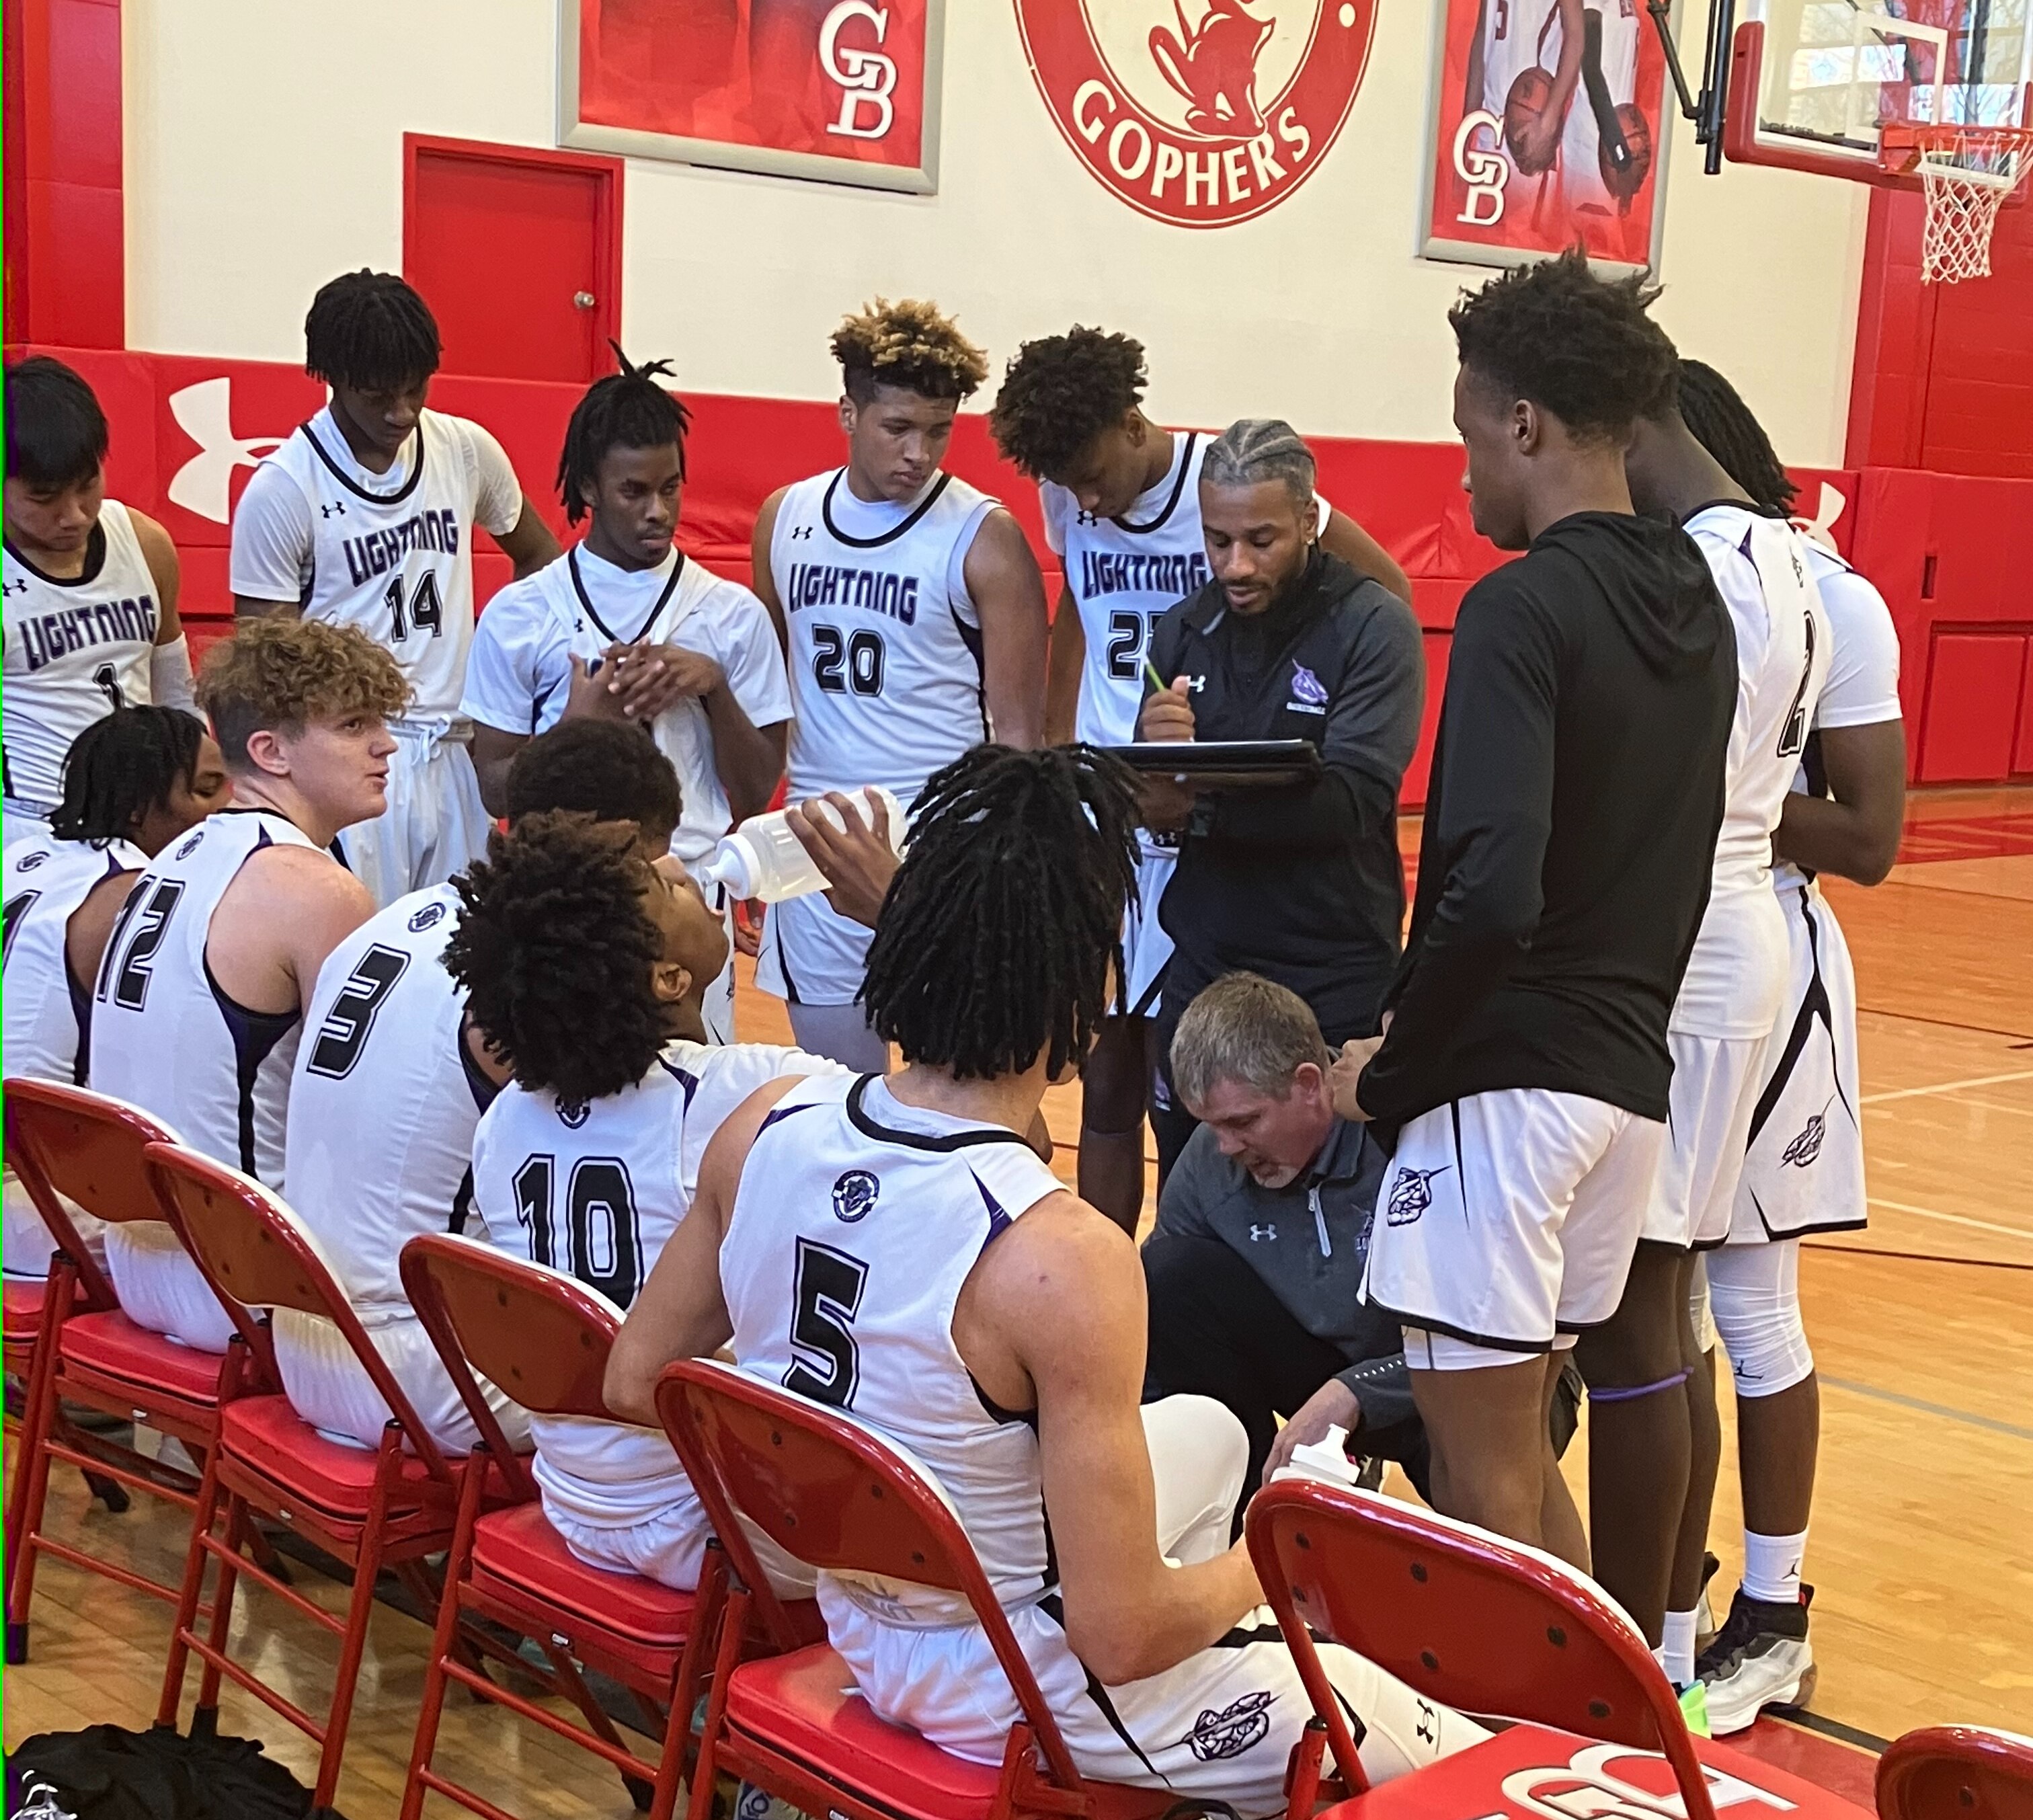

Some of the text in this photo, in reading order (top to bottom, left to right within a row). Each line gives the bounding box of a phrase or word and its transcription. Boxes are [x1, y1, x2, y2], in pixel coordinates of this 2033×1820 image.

[1072, 79, 1311, 206] GOPHERS
[342, 508, 460, 588] LIGHTNING
[1082, 550, 1207, 601] LIGHTNING
[18, 594, 157, 672] LIGHTNING
[383, 569, 444, 643] 14
[789, 562, 920, 626] LIGHTNING
[91, 662, 127, 710] 1
[811, 623, 886, 698] 20
[96, 873, 186, 1012] 12
[306, 942, 411, 1081] 3
[511, 1152, 645, 1312] 10
[781, 1234, 870, 1412] 5
